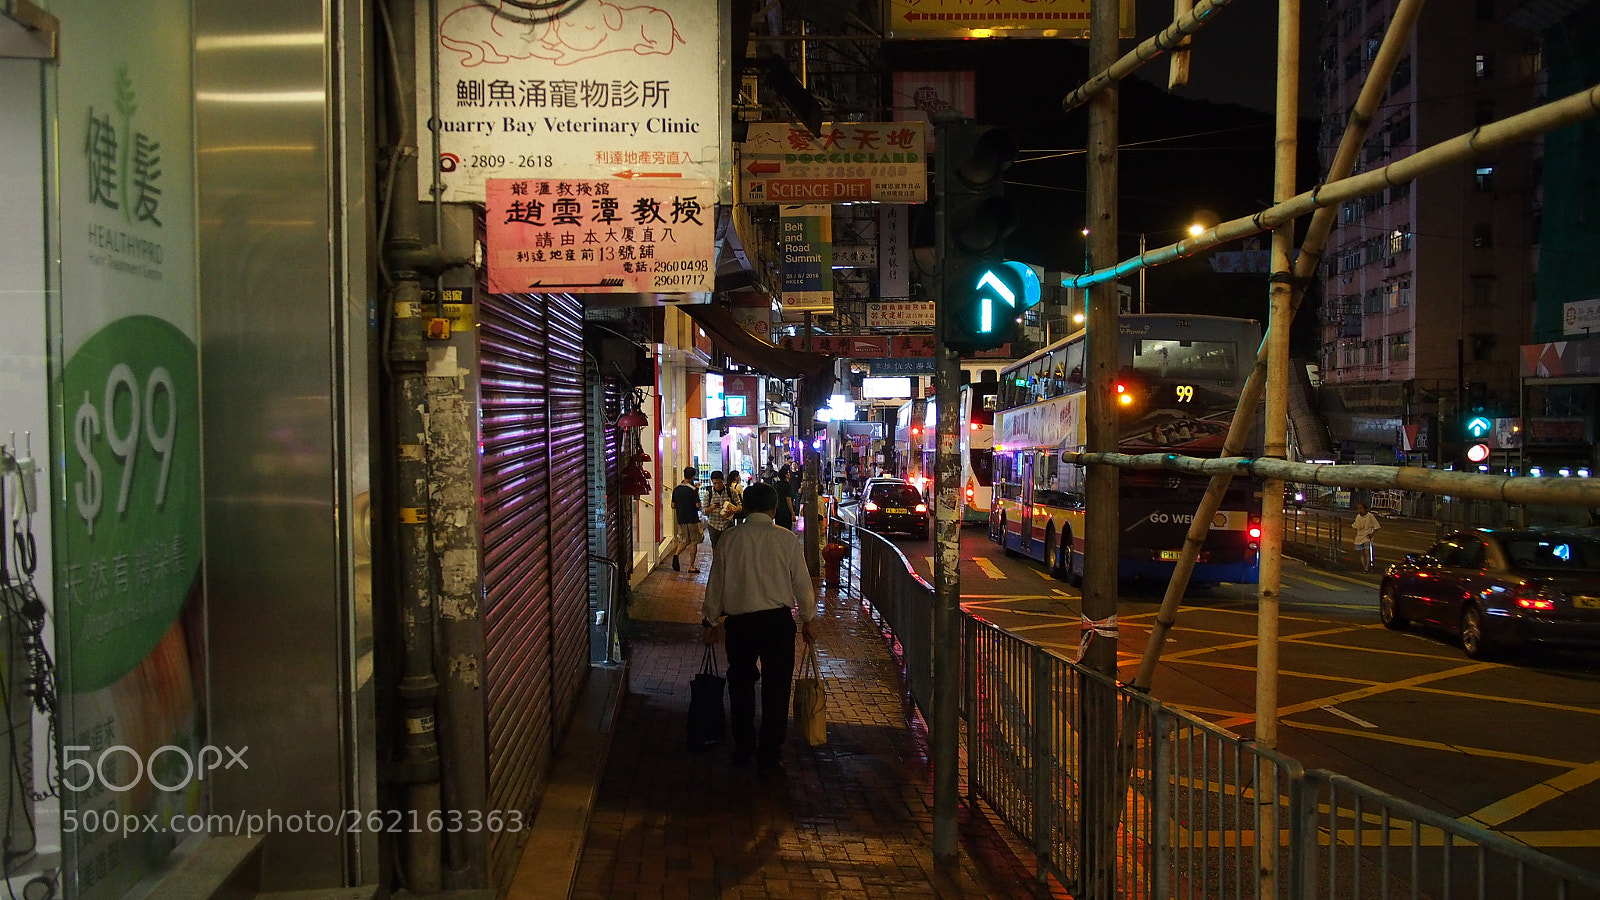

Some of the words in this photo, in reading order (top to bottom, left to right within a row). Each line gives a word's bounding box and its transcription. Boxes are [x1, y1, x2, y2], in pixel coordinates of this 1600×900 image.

[456, 79, 670, 108] 鰂魚涌寵物診所
[427, 117, 495, 136] Quarry
[502, 117, 537, 136] Bay
[544, 117, 640, 136] Veterinary
[646, 117, 700, 133] Clinic
[470, 155, 505, 168] 2809
[518, 155, 553, 168] 2618
[771, 182, 829, 198] SCIENCE
[833, 181, 866, 198] DIET
[504, 195, 703, 226] 趙雲潭教授
[784, 222, 803, 232] Belt
[784, 233, 803, 242] and
[785, 244, 810, 252] Road
[785, 254, 822, 263] Summit
[1176, 385, 1194, 403] 99
[74, 363, 177, 536] $99
[1149, 513, 1169, 524] GO
